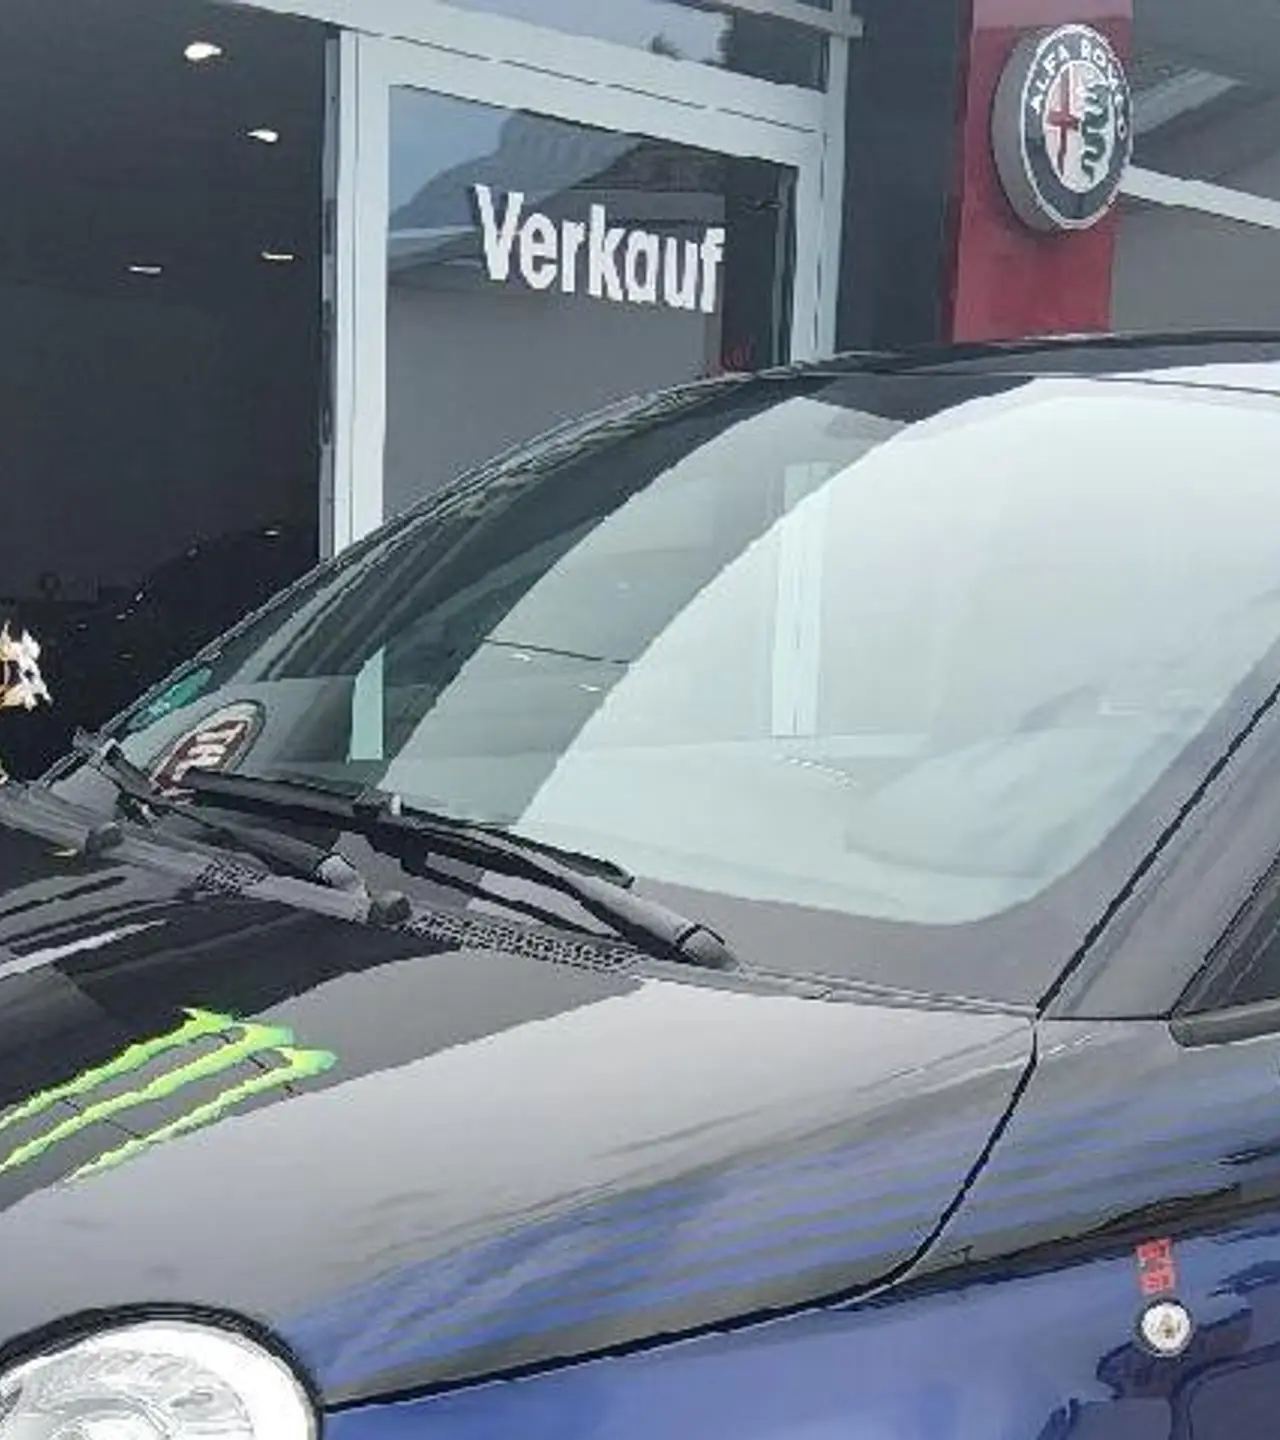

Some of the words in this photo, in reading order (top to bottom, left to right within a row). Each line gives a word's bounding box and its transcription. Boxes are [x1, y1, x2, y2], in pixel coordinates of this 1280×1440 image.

[1029, 45, 1071, 115] ALFA
[1080, 38, 1128, 141] ROMEO
[474, 183, 726, 314] Verkauf
